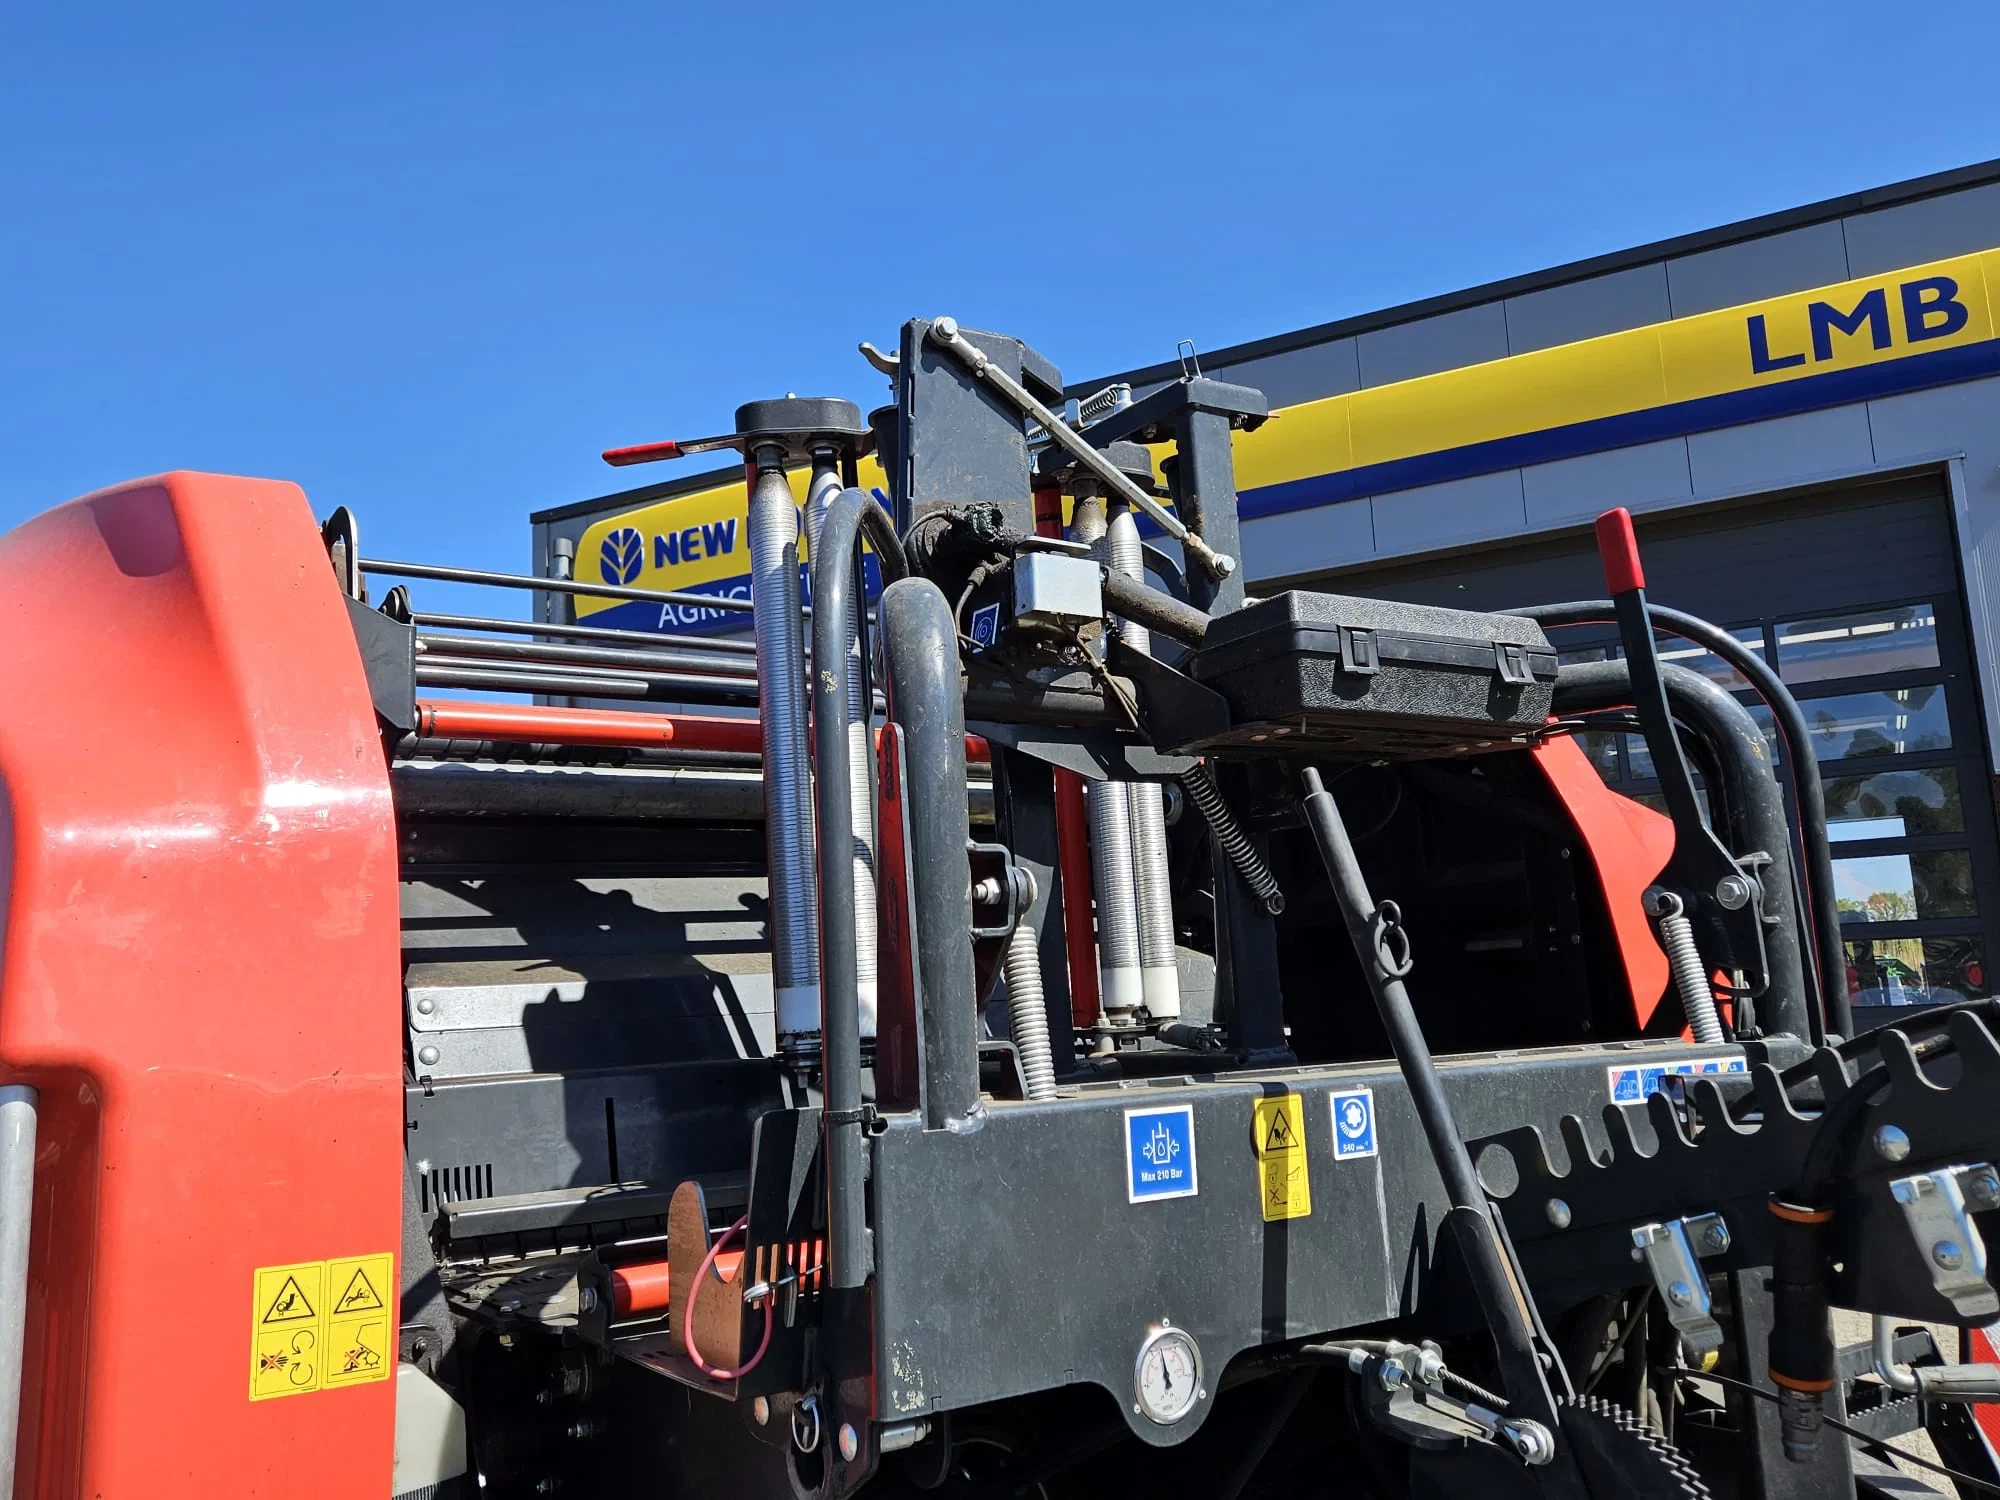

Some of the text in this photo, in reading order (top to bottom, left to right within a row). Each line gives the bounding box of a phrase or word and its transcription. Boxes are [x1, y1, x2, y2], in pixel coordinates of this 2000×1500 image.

[1747, 276, 1968, 374] LMB
[653, 517, 738, 569] NEW
[1343, 1143, 1355, 1152] 540
[1141, 1168, 1183, 1182] Max 210 Bar
